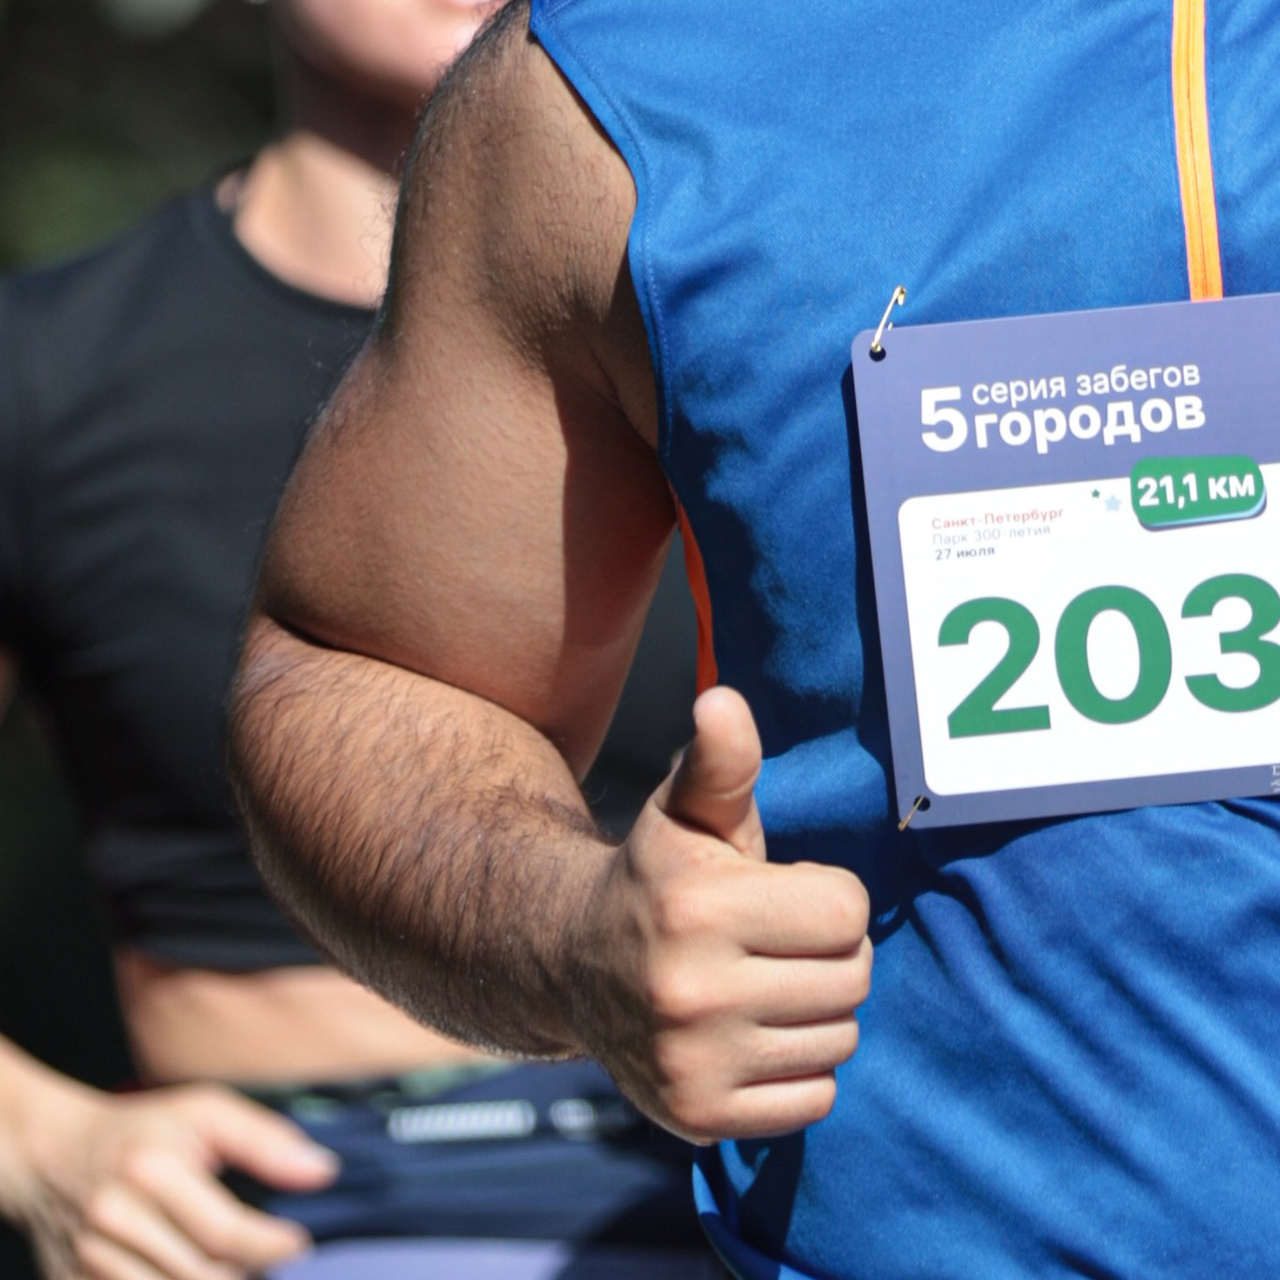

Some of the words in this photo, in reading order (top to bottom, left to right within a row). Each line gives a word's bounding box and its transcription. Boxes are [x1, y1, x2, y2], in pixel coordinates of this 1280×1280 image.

[972, 375, 1066, 408] серия
[1076, 364, 1201, 396] забегов
[921, 385, 968, 452] 5
[974, 395, 1206, 454] городов
[1137, 473, 1198, 509] 21,1
[1208, 473, 1255, 500] км
[931, 508, 1064, 530] Санкт-Петербург
[932, 533, 968, 545] Парк
[974, 526, 1051, 542] 300-летия
[935, 548, 952, 561] 27
[956, 546, 995, 559] июля
